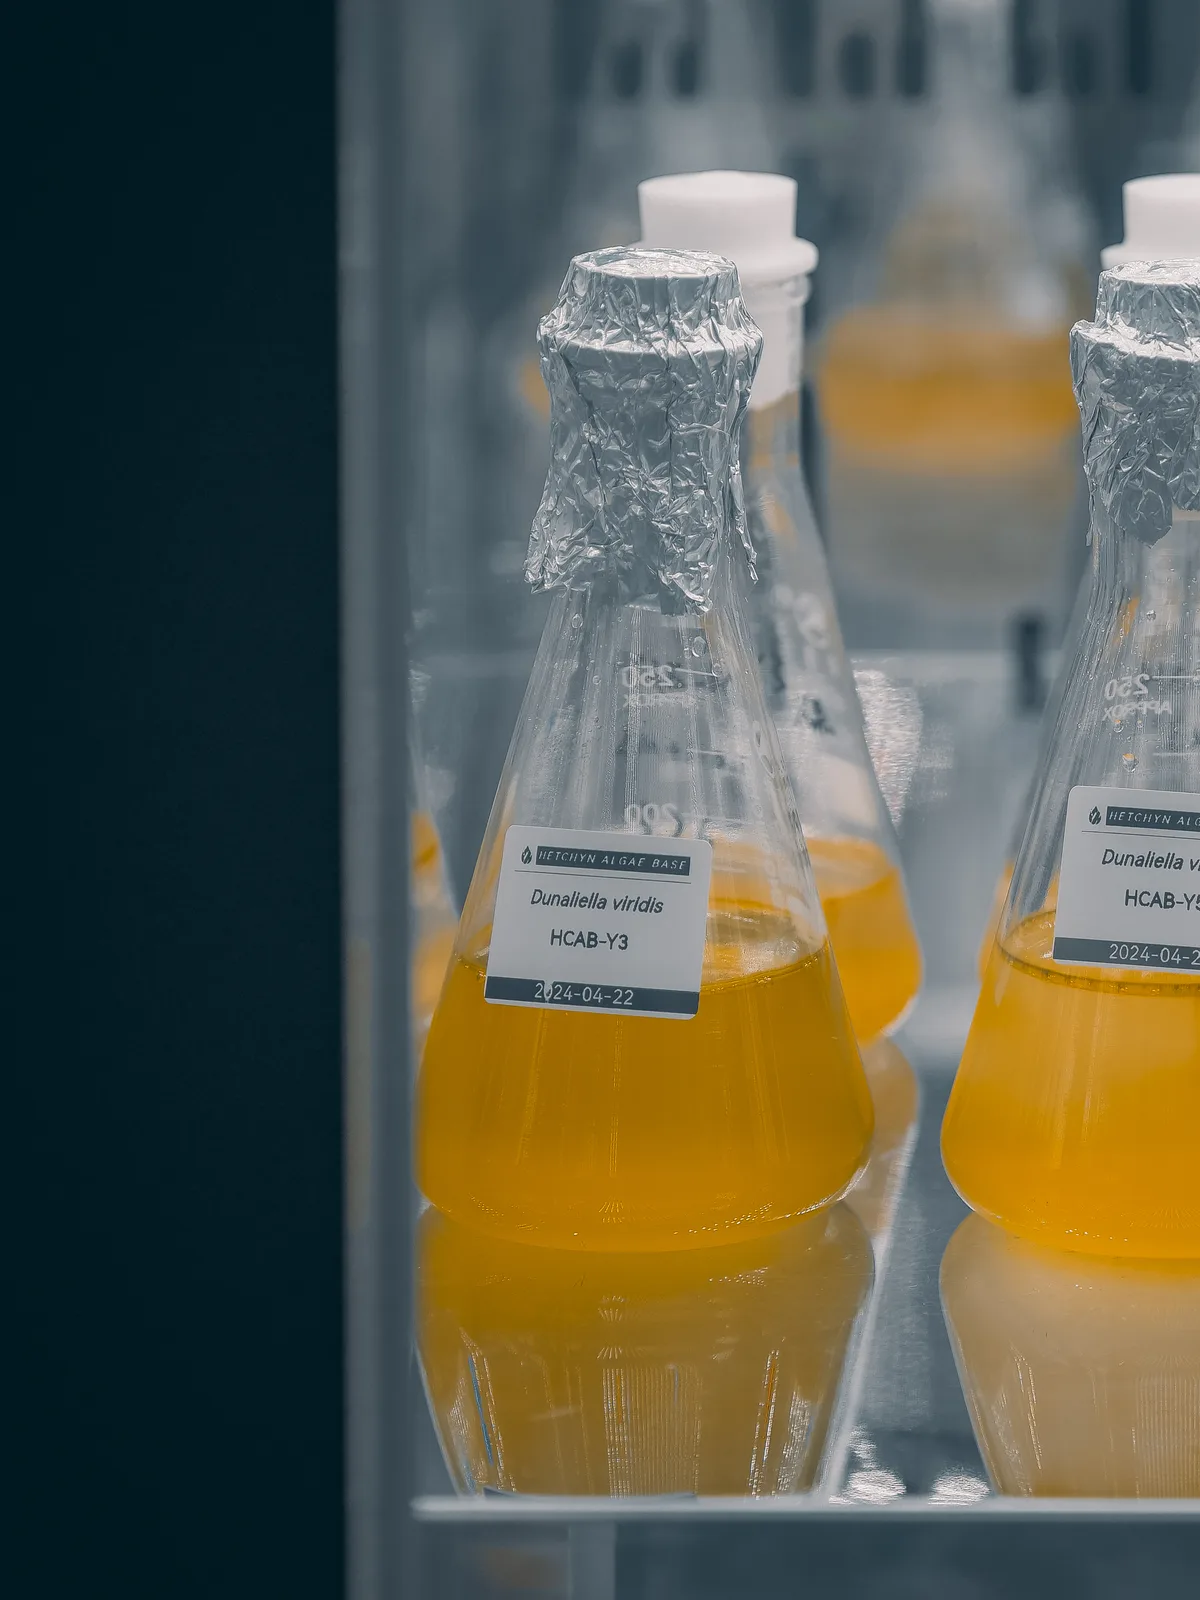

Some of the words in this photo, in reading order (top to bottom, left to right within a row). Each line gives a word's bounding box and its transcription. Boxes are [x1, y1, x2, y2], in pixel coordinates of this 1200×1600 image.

[1108, 811, 1172, 825] HETCHYN
[537, 850, 596, 864] HETCHYN
[600, 855, 646, 867] ALGAE
[651, 858, 687, 870] BASE
[1101, 849, 1184, 870] Dunaliella
[530, 888, 608, 910] Dunaliella
[613, 895, 664, 914] viridis
[550, 928, 629, 950] HCAB-Y3
[534, 982, 634, 1006] 2024-04-22
